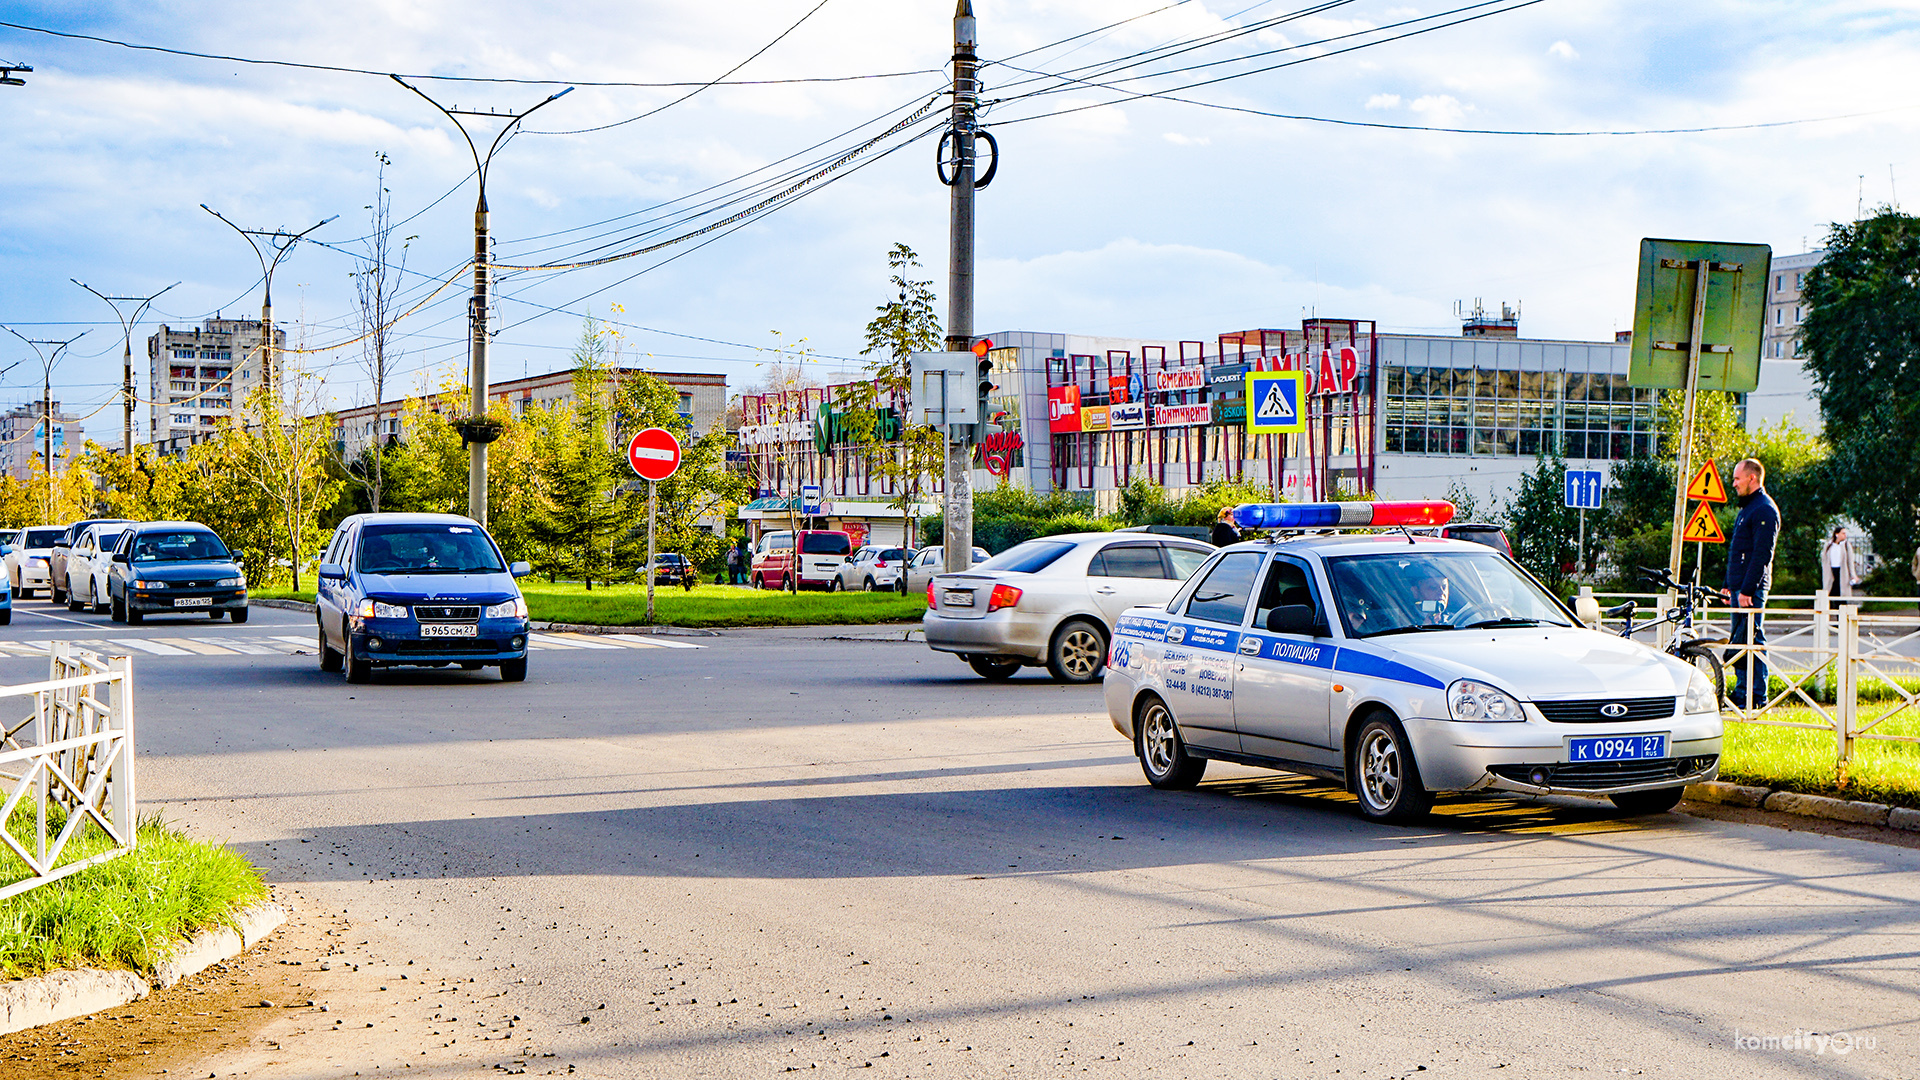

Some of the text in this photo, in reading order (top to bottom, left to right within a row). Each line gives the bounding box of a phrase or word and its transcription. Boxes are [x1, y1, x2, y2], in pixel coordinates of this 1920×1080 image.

[1156, 367, 1202, 390] Семейный
[1210, 374, 1241, 384] LAZURIT
[1155, 406, 1209, 425] Континент
[1223, 406, 1248, 418] askon
[1272, 642, 1320, 662] ПОЛИЦИЯ
[1166, 679, 1187, 691] 52-44-88
[1212, 687, 1233, 700] 387-387
[1594, 739, 1635, 758] 0994
[1643, 737, 1659, 751] 27
